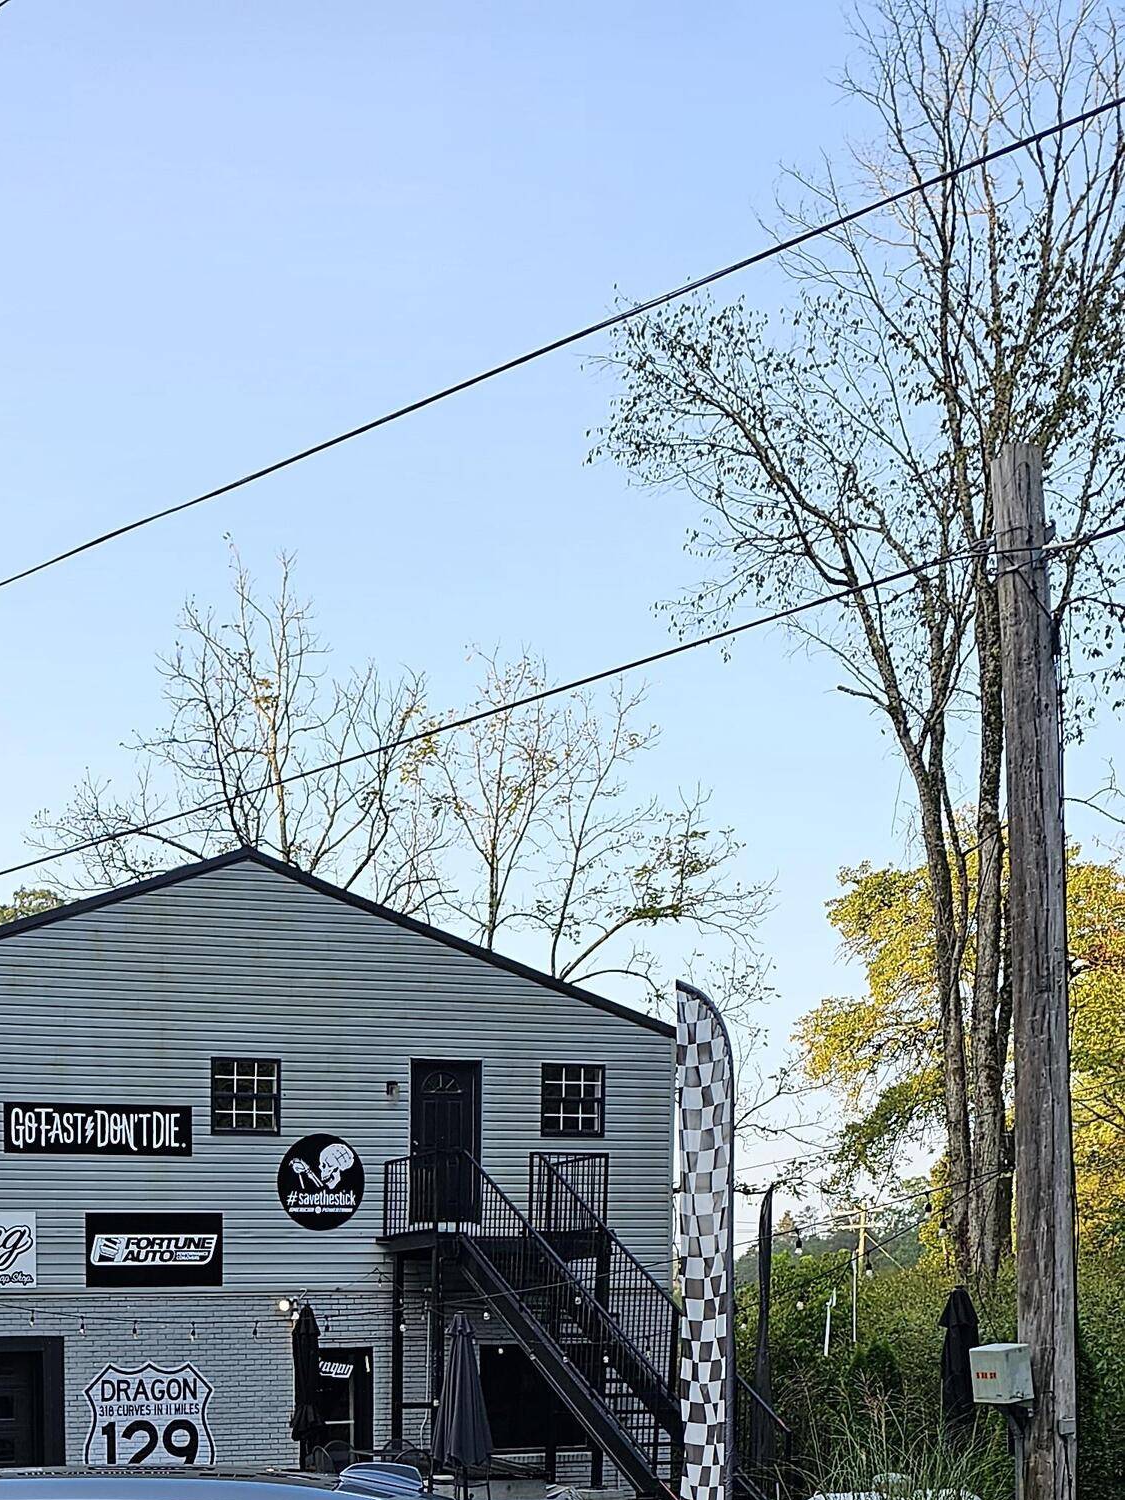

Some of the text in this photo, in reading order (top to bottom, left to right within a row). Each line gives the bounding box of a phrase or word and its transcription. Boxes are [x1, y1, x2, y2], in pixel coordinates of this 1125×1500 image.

[286, 1189, 356, 1206] #savethestick
[125, 1237, 214, 1250] FORTUNE
[122, 1249, 175, 1262] AUTO
[101, 1378, 198, 1402] DRAGON
[99, 1405, 115, 1417] 318
[117, 1404, 151, 1416] CURVES
[155, 1404, 163, 1416] IN
[174, 1403, 200, 1415] MILES
[101, 1418, 199, 1465] 129
